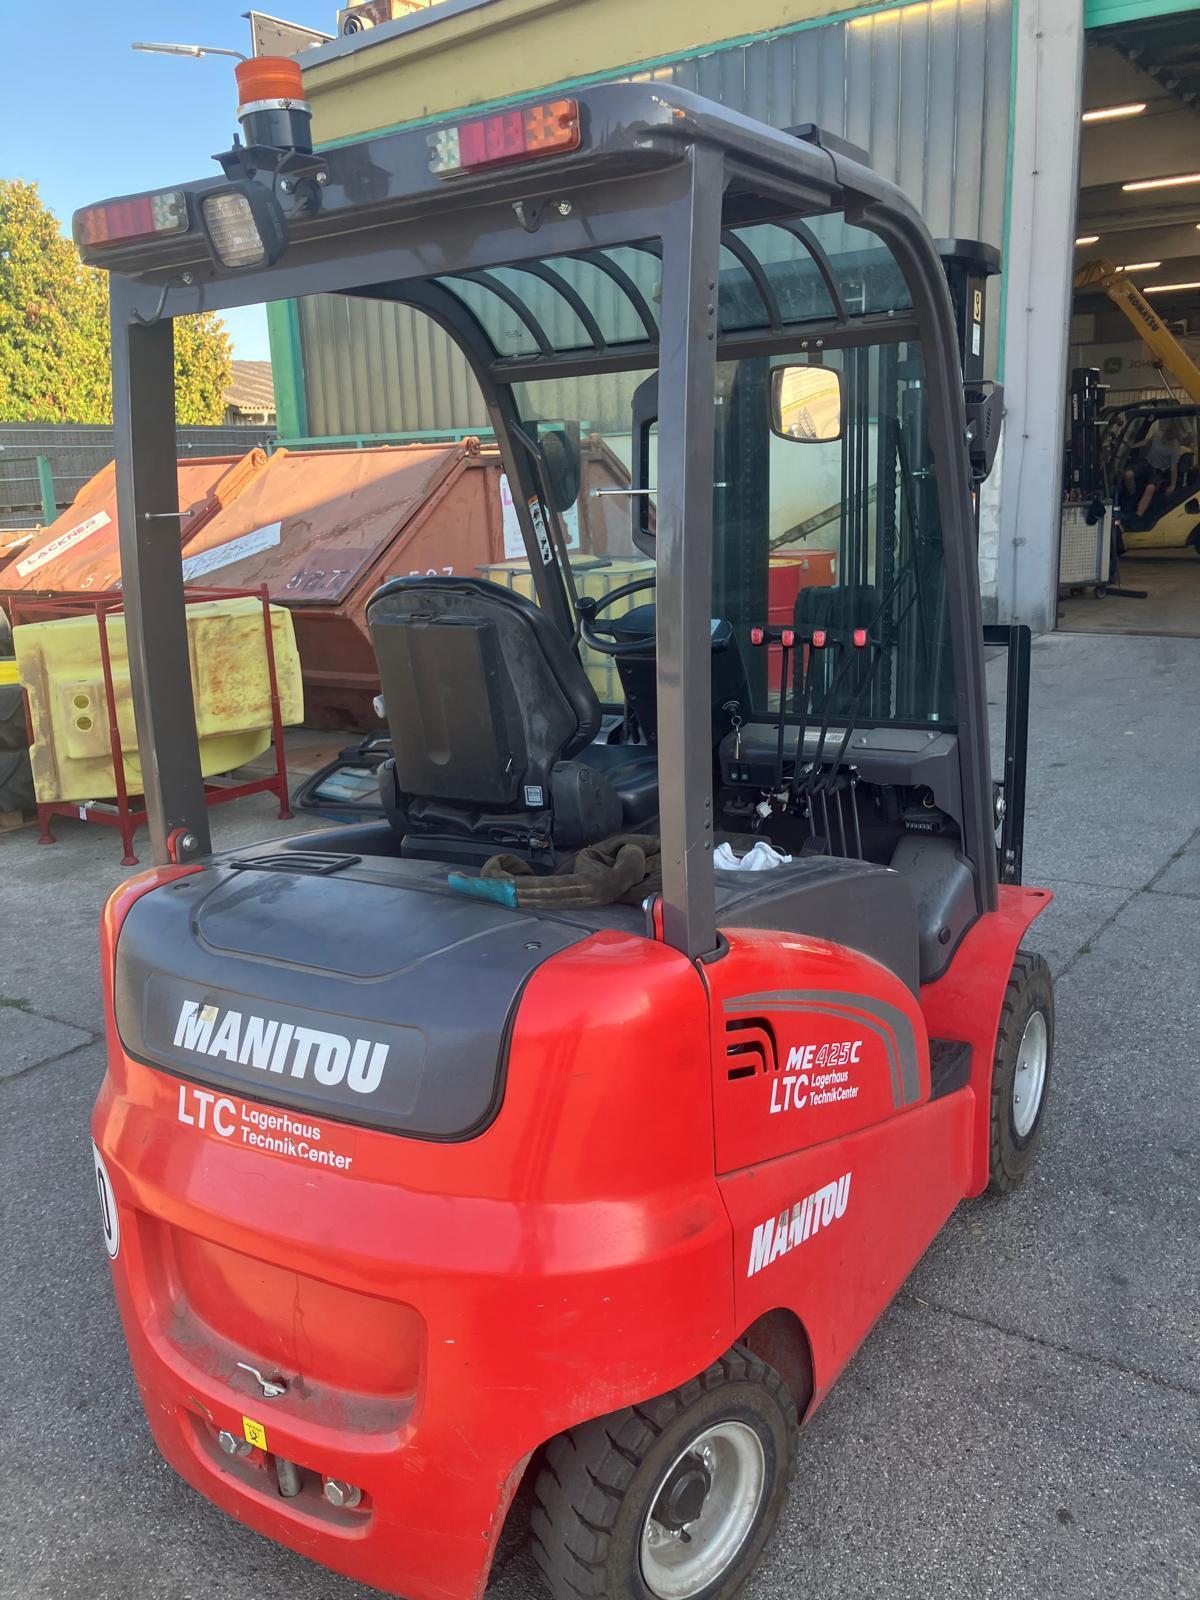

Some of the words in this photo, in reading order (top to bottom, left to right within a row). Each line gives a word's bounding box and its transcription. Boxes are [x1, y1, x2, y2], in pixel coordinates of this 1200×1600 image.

[1128, 293, 1160, 332] KOMATSU
[27, 519, 97, 565] LACKNER
[173, 1000, 390, 1094] MANITOU
[177, 1084, 237, 1137] LTC
[241, 1104, 322, 1141] Lagerhaus
[770, 1073, 809, 1113] LTC
[811, 1069, 849, 1089] Lagerhaus
[810, 1086, 860, 1106] TechnikCenter
[240, 1126, 353, 1170] TechnikCenter
[747, 1171, 852, 1279] MANITOU
